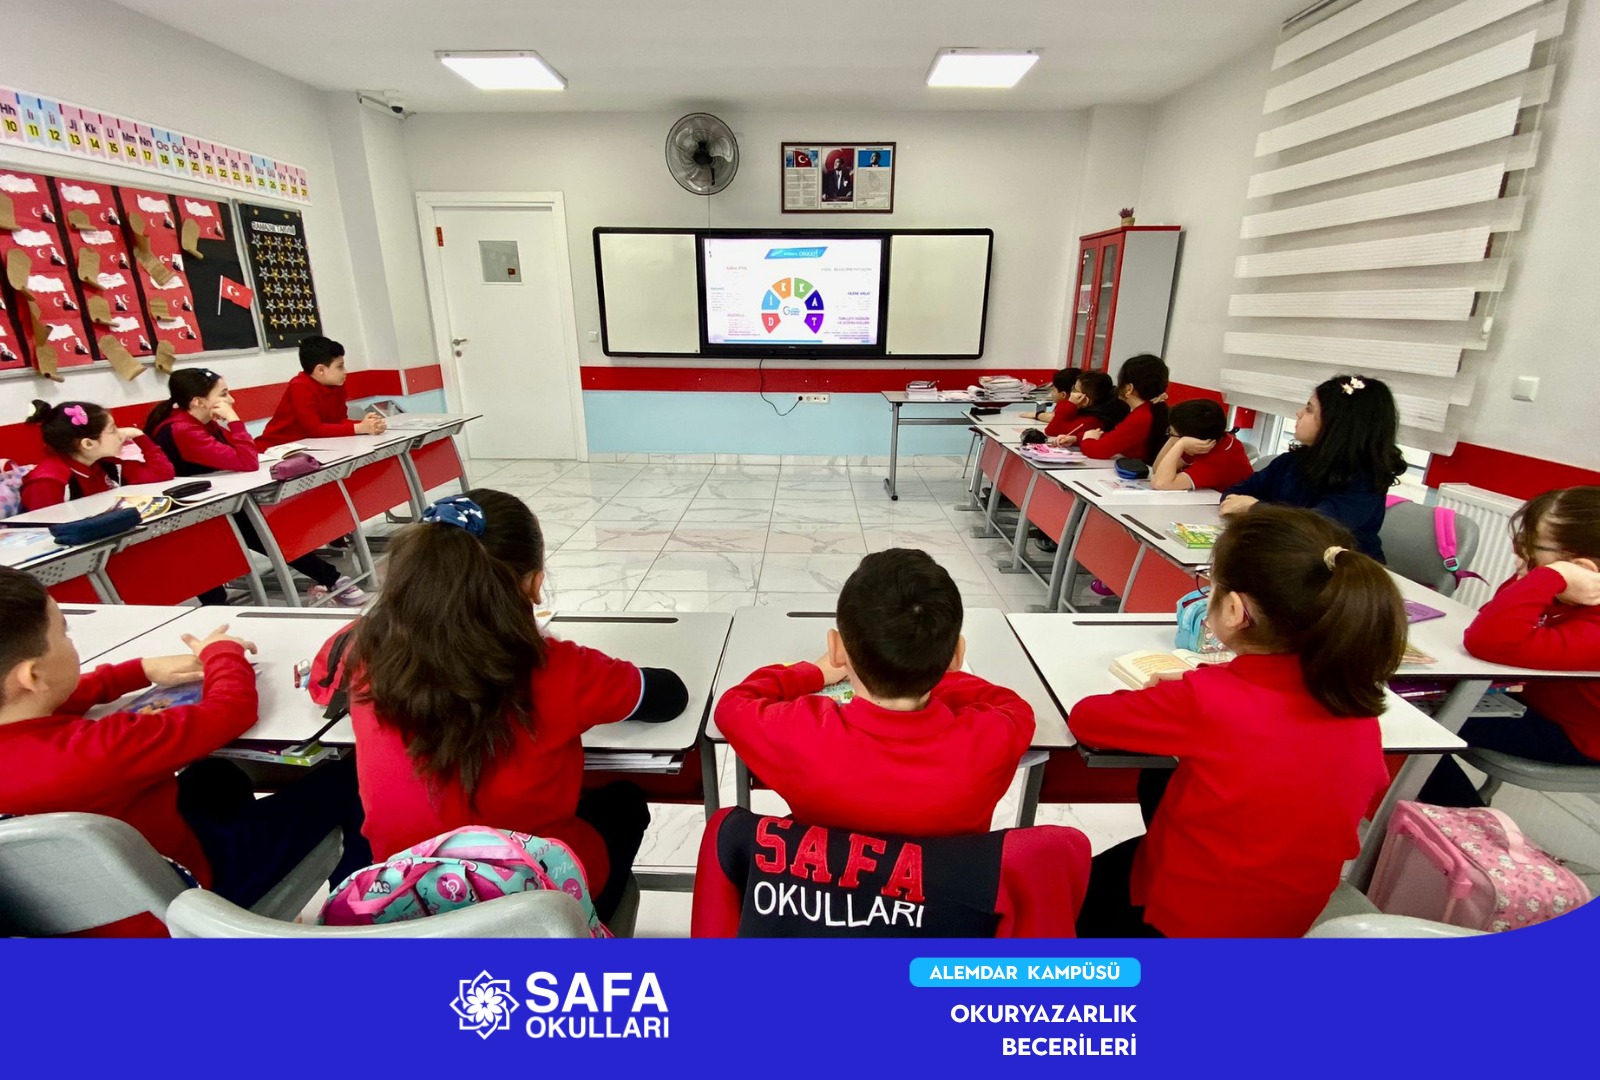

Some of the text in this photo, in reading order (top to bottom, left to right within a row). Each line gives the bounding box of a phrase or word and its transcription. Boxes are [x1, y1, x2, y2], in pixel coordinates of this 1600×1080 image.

[0, 103, 16, 117] Hh
[69, 119, 78, 132] Jj
[84, 122, 97, 135] Kk
[122, 132, 137, 144] Mm
[139, 136, 152, 148] Nn
[156, 140, 169, 152] Oo
[5, 119, 17, 132] 10
[29, 125, 39, 137] 11
[49, 129, 60, 141] 12
[69, 133, 81, 145] 13
[90, 138, 100, 149] 14
[109, 143, 119, 153] 15
[126, 147, 137, 158] 16
[143, 151, 152, 161] 17
[160, 154, 169, 165] 18
[176, 159, 185, 168] 19
[191, 162, 199, 172] 20
[206, 165, 214, 174] 21
[219, 168, 227, 178] 22
[232, 172, 240, 181] 23
[245, 175, 252, 183] 24
[755, 816, 925, 902] SAFA
[754, 881, 925, 928] OKULLARI
